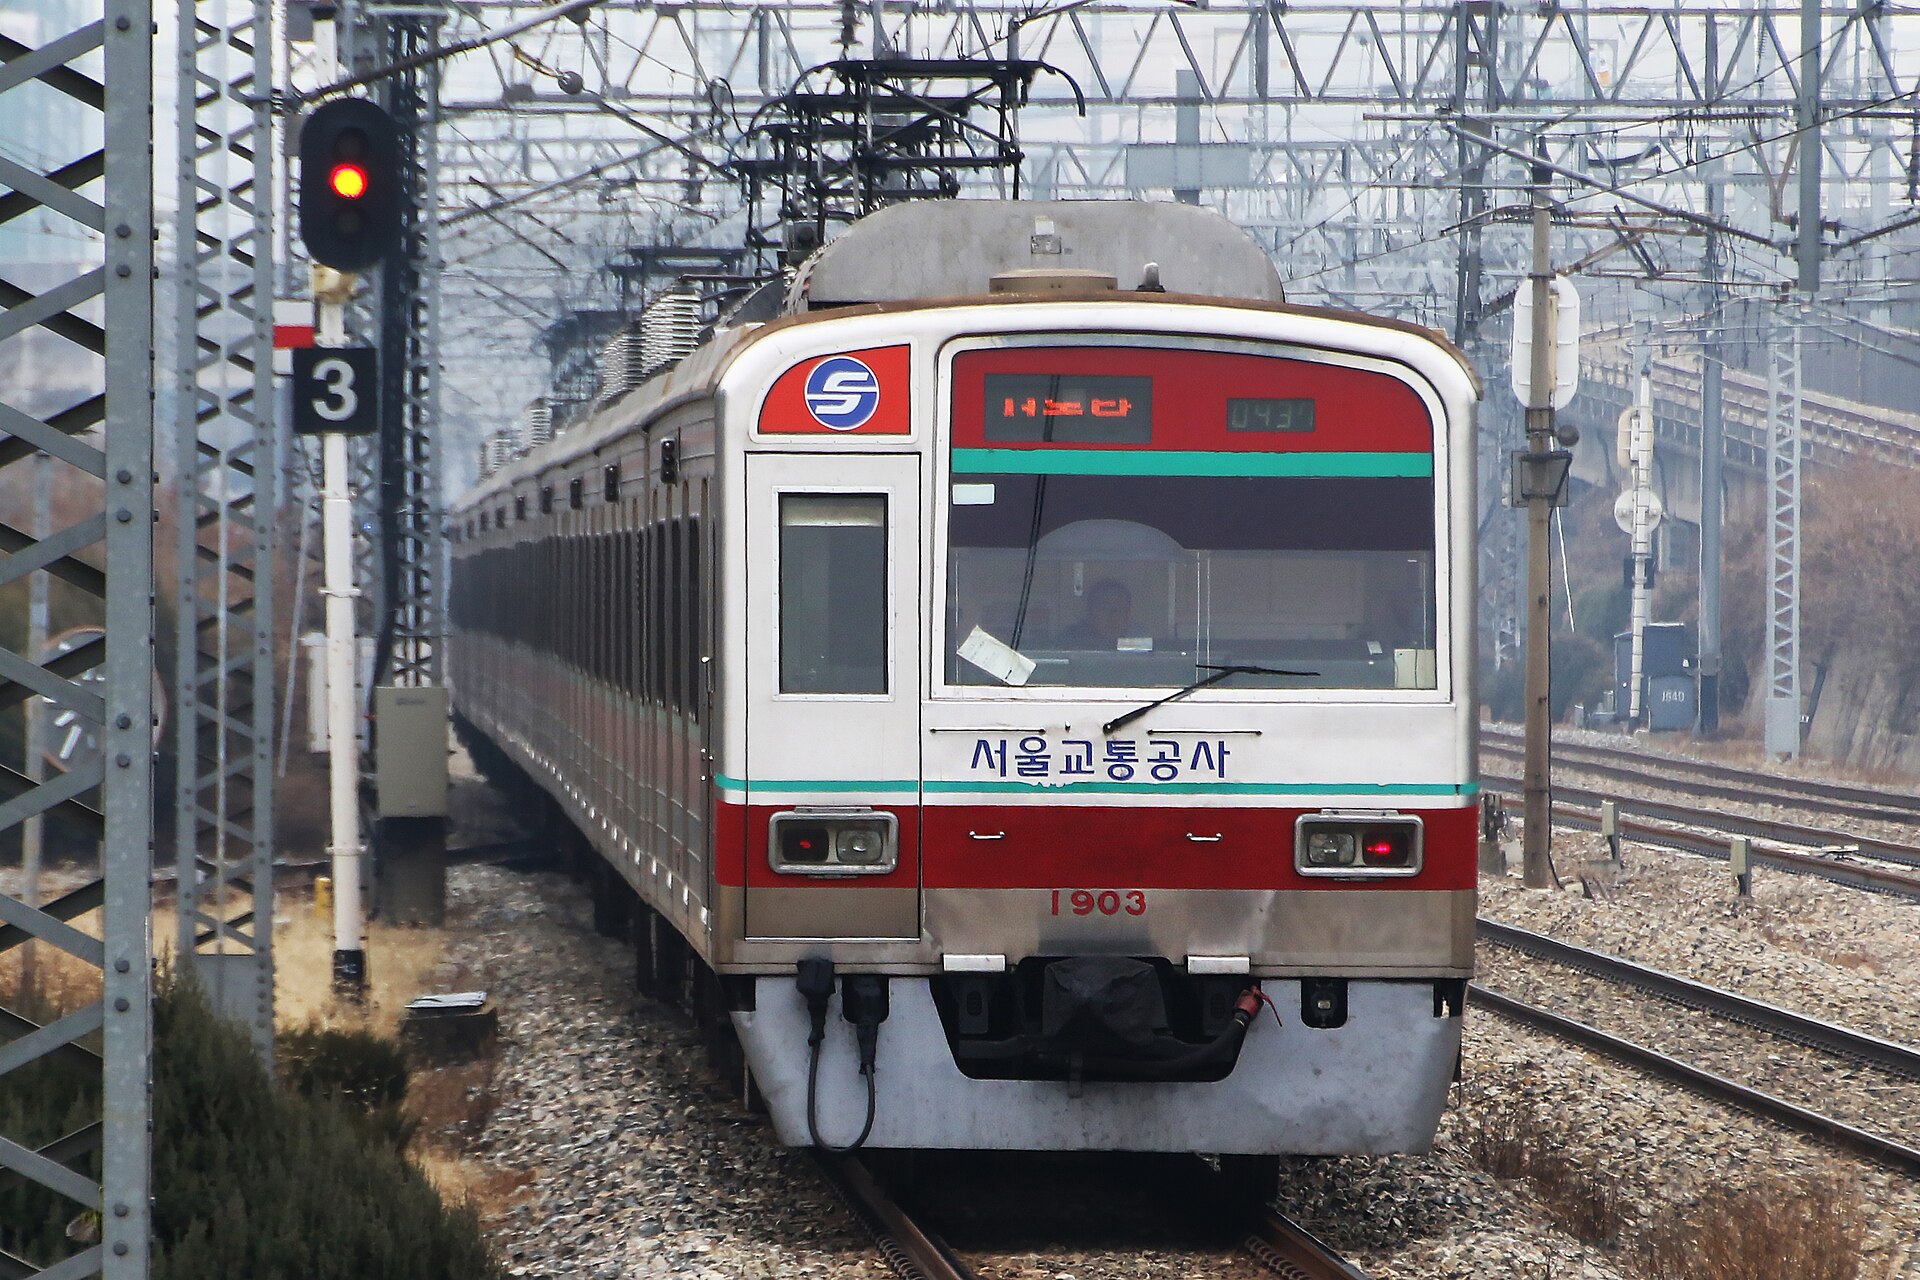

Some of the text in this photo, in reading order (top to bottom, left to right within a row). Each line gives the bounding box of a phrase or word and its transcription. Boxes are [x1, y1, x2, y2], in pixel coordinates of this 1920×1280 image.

[312, 358, 358, 421] 3
[971, 736, 1231, 781] 서울교통공사
[1051, 890, 1147, 916] 1903
